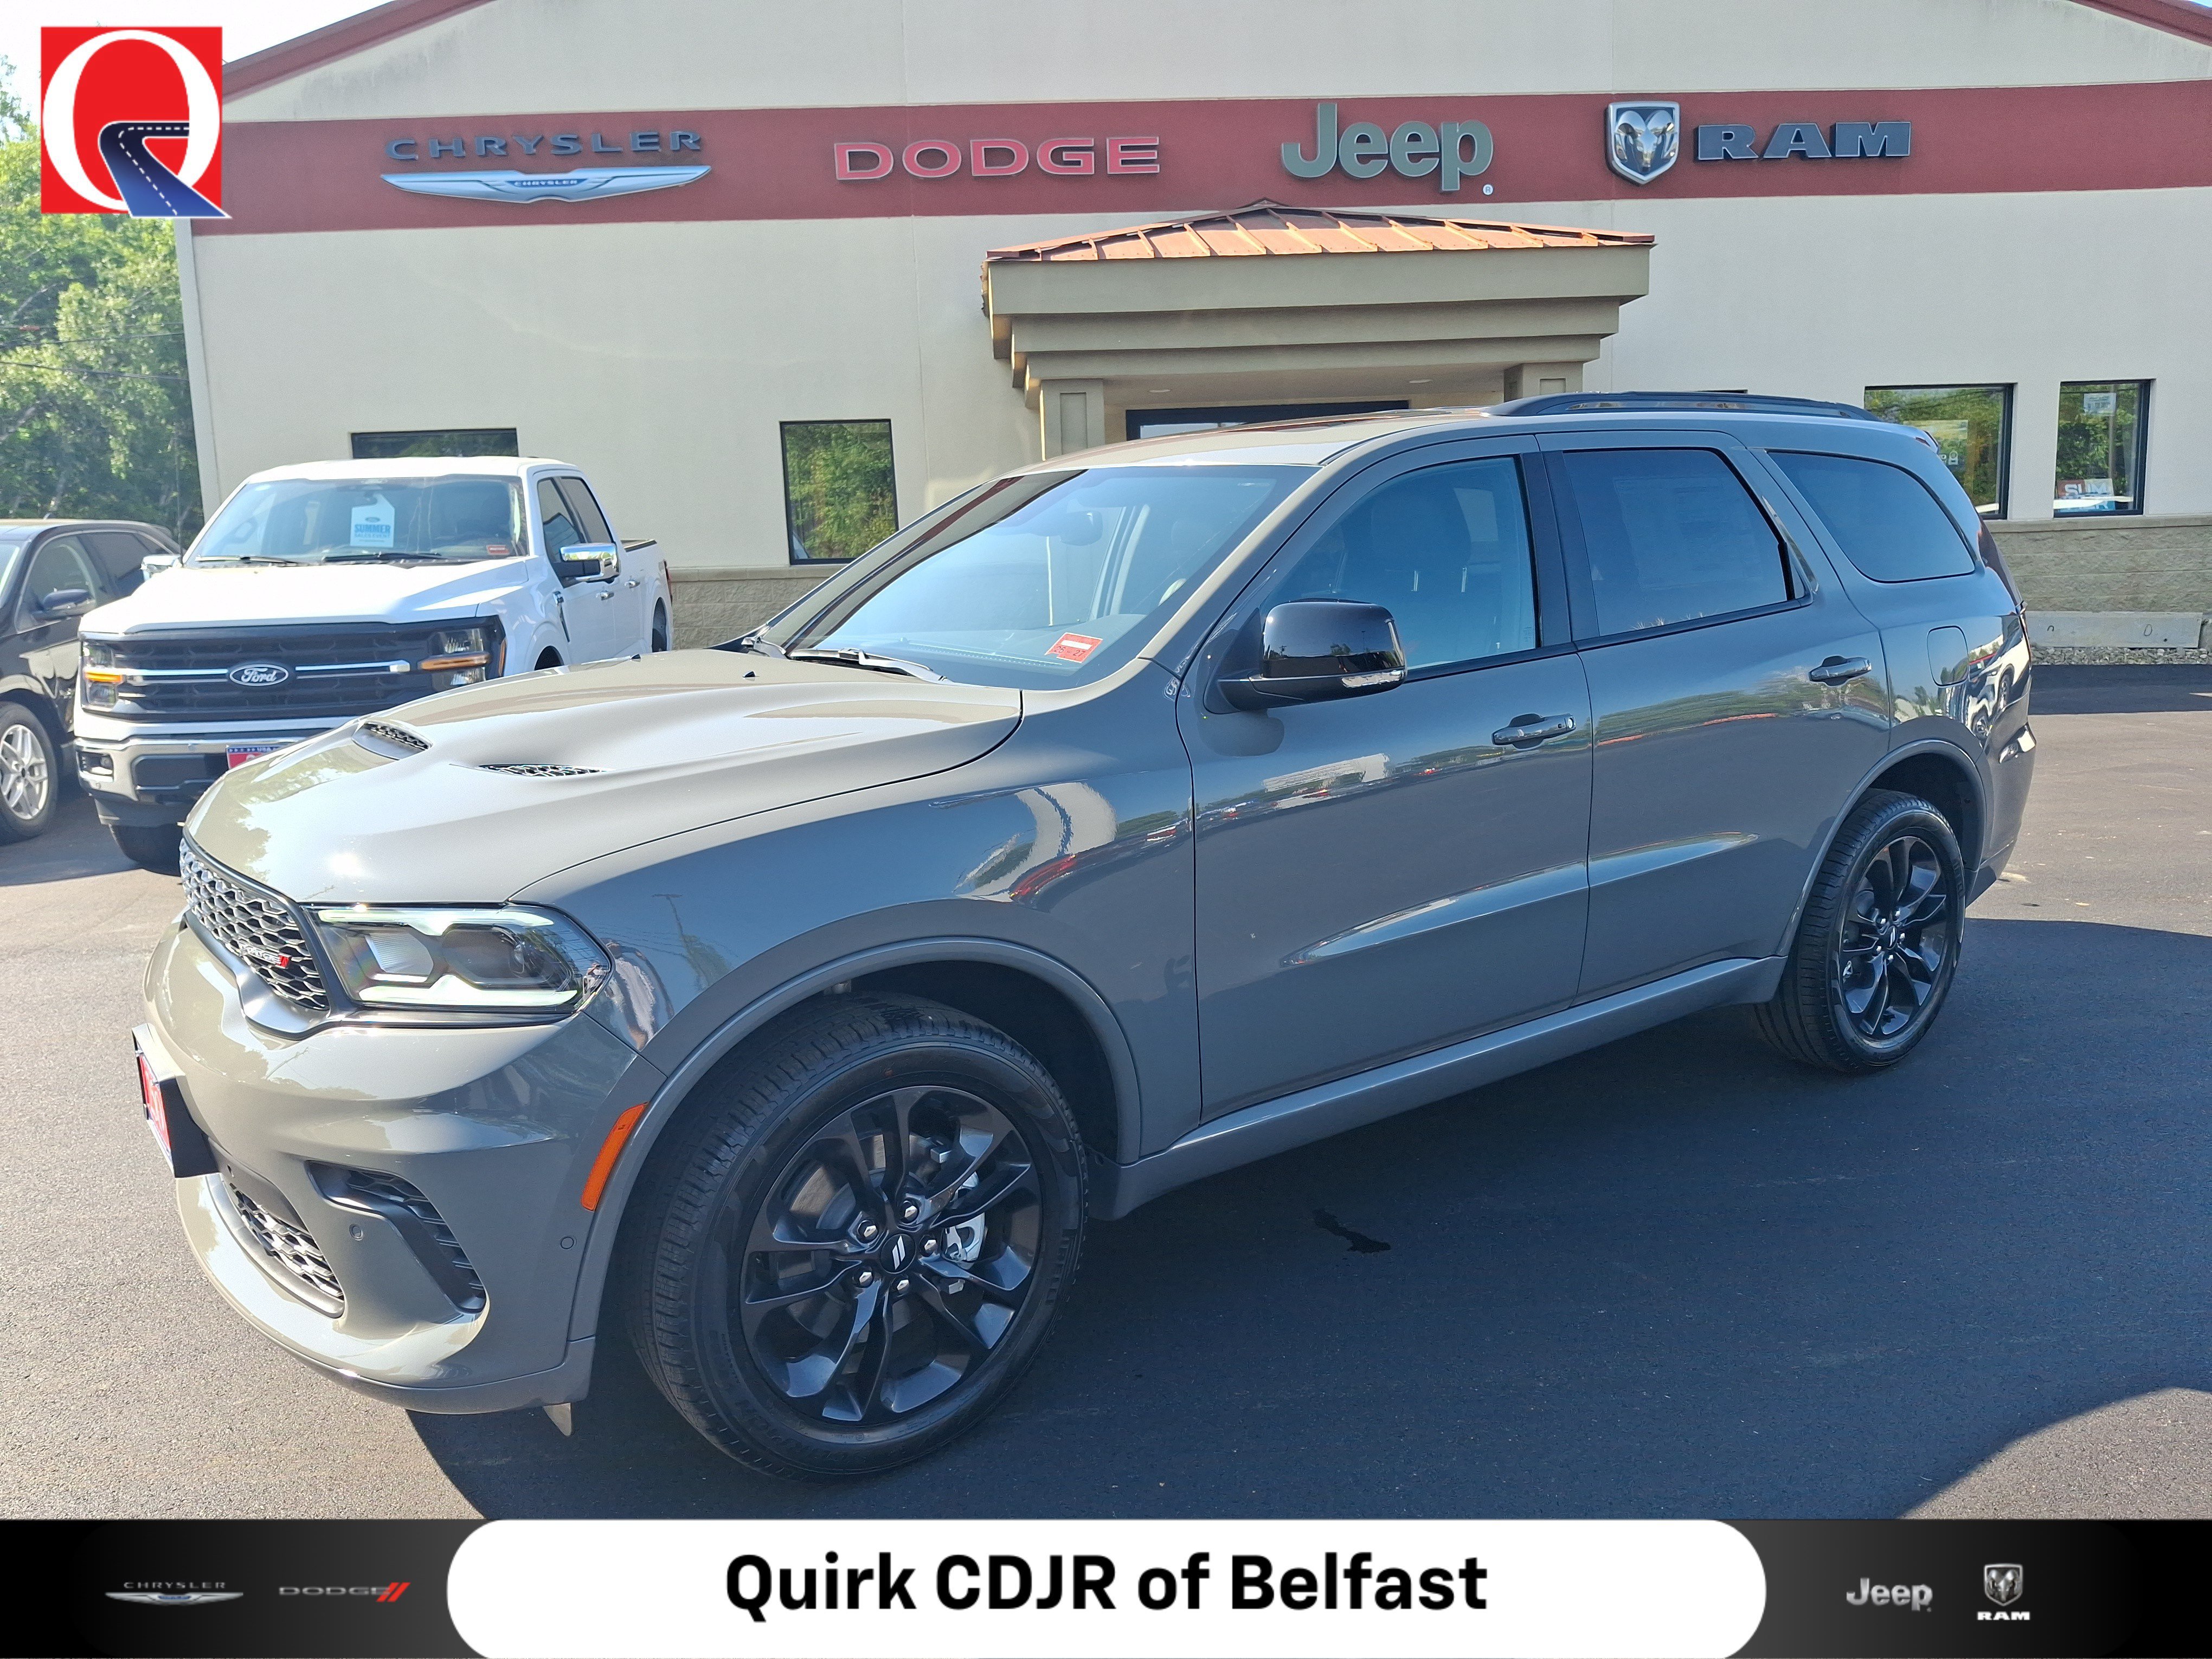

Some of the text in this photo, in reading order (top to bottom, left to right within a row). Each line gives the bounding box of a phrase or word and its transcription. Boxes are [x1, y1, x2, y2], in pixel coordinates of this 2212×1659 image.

[384, 131, 702, 160] CHRYSLER
[1281, 102, 1494, 192] Jeep
[1696, 120, 1912, 161] RAM
[833, 136, 1161, 181] DODGE
[354, 523, 391, 533] SUMMER
[241, 667, 277, 683] Ford
